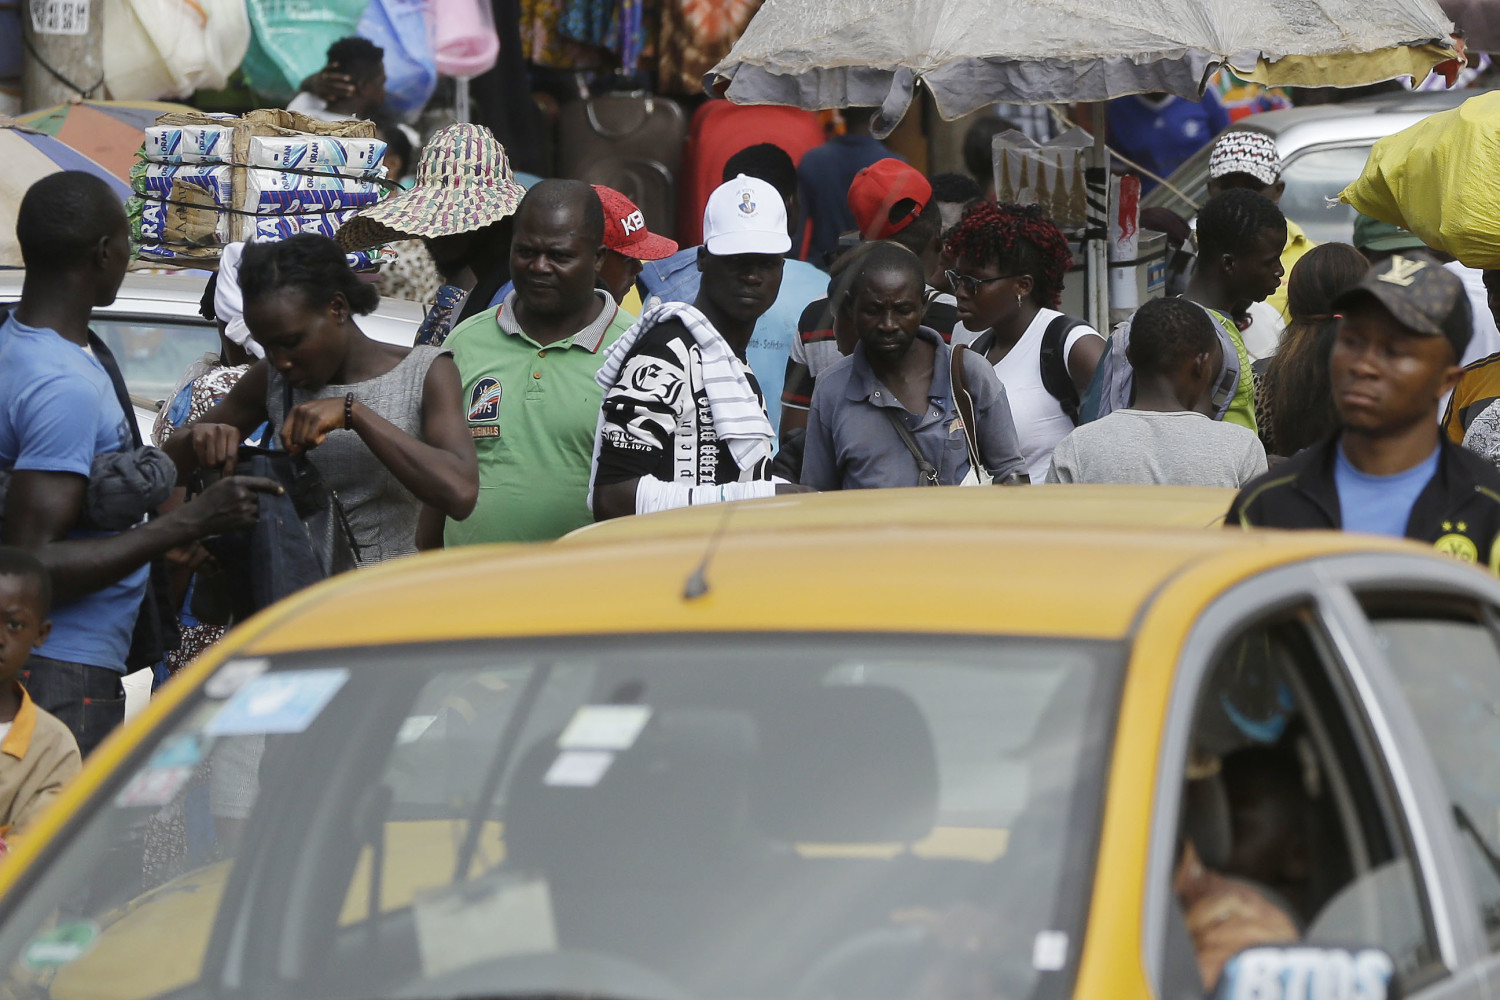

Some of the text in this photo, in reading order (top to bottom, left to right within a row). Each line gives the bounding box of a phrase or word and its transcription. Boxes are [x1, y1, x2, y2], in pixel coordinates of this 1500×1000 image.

[160, 130, 168, 155] ORAN
[309, 142, 319, 164] ORAN
[283, 144, 292, 166] ORAN
[367, 143, 375, 165] ORAN
[471, 426, 499, 437] RIGINALS
[677, 420, 694, 478] plein
